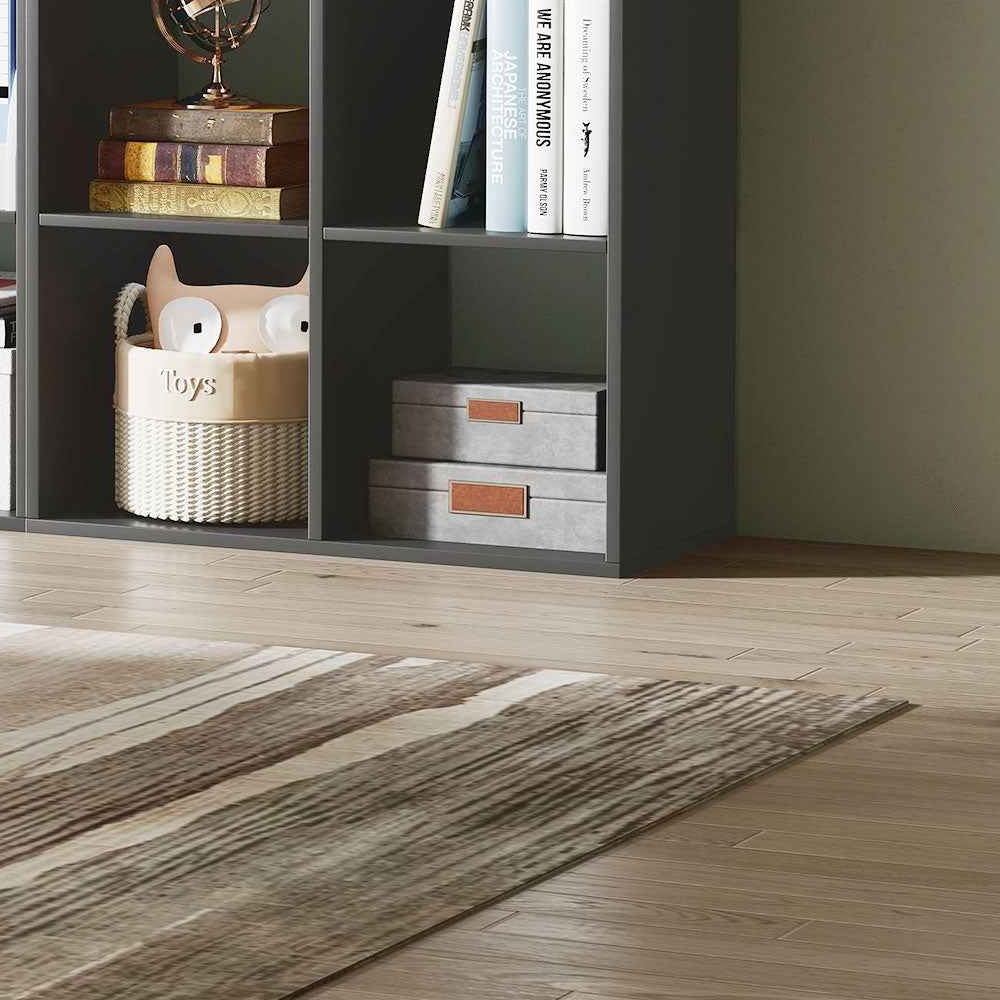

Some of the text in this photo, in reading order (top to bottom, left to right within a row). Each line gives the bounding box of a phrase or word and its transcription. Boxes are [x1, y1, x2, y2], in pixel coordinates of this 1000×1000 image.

[490, 49, 504, 185] ARCHITECTURE
[503, 50, 518, 140] JAPANESE
[535, 8, 552, 148] WE ARE ANONYMOUS
[539, 169, 548, 216] PARMY OLSON
[160, 368, 217, 402] Toys
